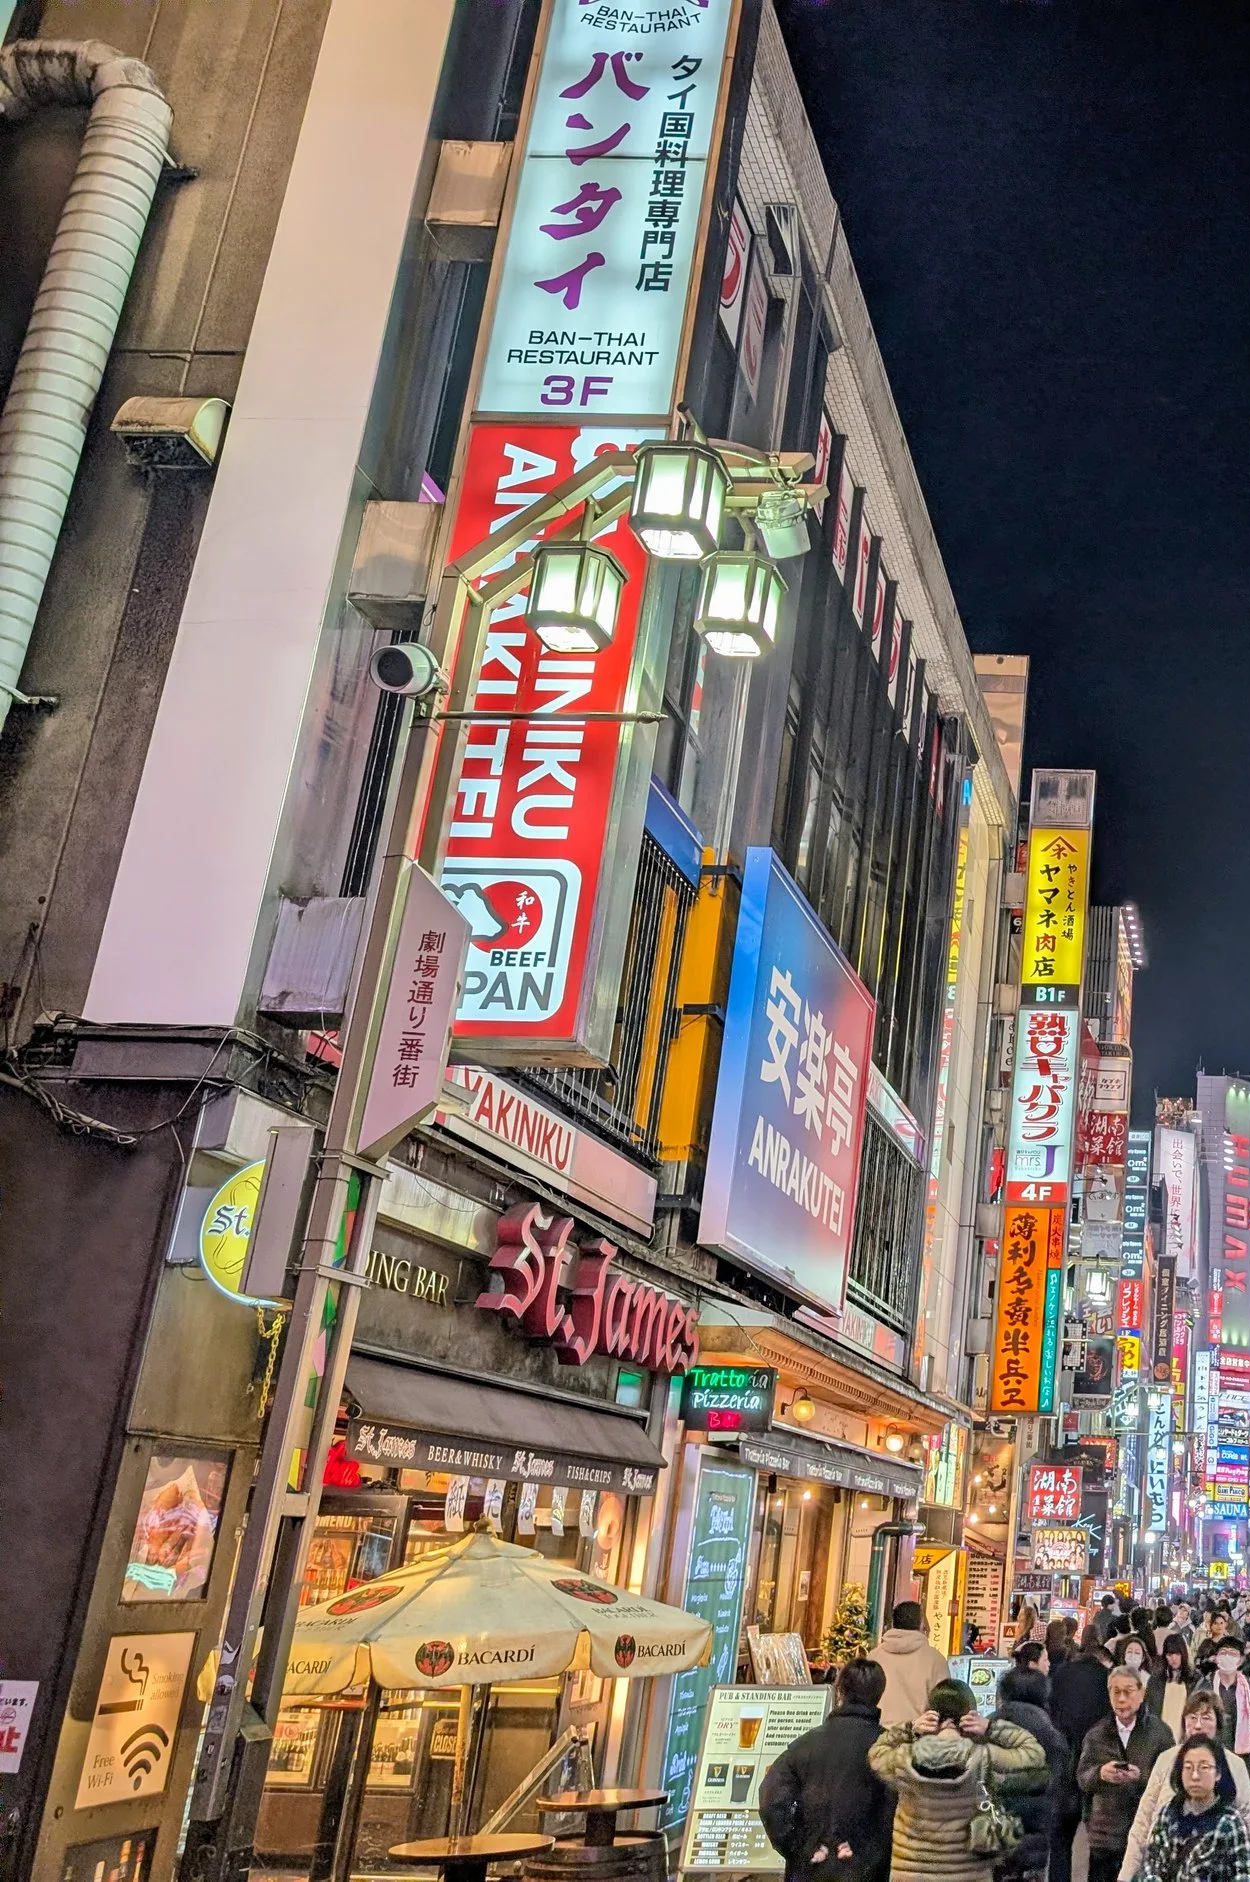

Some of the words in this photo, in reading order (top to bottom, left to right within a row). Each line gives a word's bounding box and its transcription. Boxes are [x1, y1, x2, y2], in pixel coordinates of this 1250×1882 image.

[580, 12, 703, 35] RESTAURANT
[597, 5, 688, 23] BAN-THAI
[533, 51, 651, 311] バンタイ
[634, 54, 703, 293] タイ国料理専門店
[527, 329, 646, 347] BAN-THAI
[506, 349, 660, 367] RESTAURANT
[540, 374, 613, 406] 3F
[511, 889, 537, 935] 和牛
[1061, 862, 1078, 941] やきとん酒場
[1030, 864, 1062, 978] ヤマネ肉店
[490, 948, 547, 969] BEEF
[1035, 986, 1066, 1003] B1F
[392, 928, 448, 1089] 劇場通り一番街
[760, 964, 859, 1158] 安楽亭
[1017, 1012, 1072, 1143] 熟女キャバクラ
[461, 1065, 574, 1171] YAKINIKU
[1027, 1144, 1065, 1178] J
[747, 1115, 846, 1237] ANRAKUTEI
[1021, 1183, 1052, 1201] 4F
[207, 1202, 251, 1239] St.
[414, 1265, 450, 1307] BAR
[427, 1445, 504, 1471] BEER&WHISKY
[566, 1465, 612, 1485] FISH&CHIPS
[1034, 1468, 1078, 1495] 湖南
[1041, 1494, 1077, 1518] 菜館
[1214, 1503, 1248, 1517] SAUNA
[456, 1644, 536, 1666] BACARDÍ
[637, 1640, 687, 1659] BACARDÍ
[151, 1670, 185, 1687] Smoking
[150, 1686, 181, 1701] allowed
[719, 1692, 734, 1701] PUB
[740, 1692, 776, 1701] STANDING
[777, 1692, 792, 1701] BAR
[92, 1753, 114, 1769] Free
[87, 1771, 114, 1790] Wi-Fi
